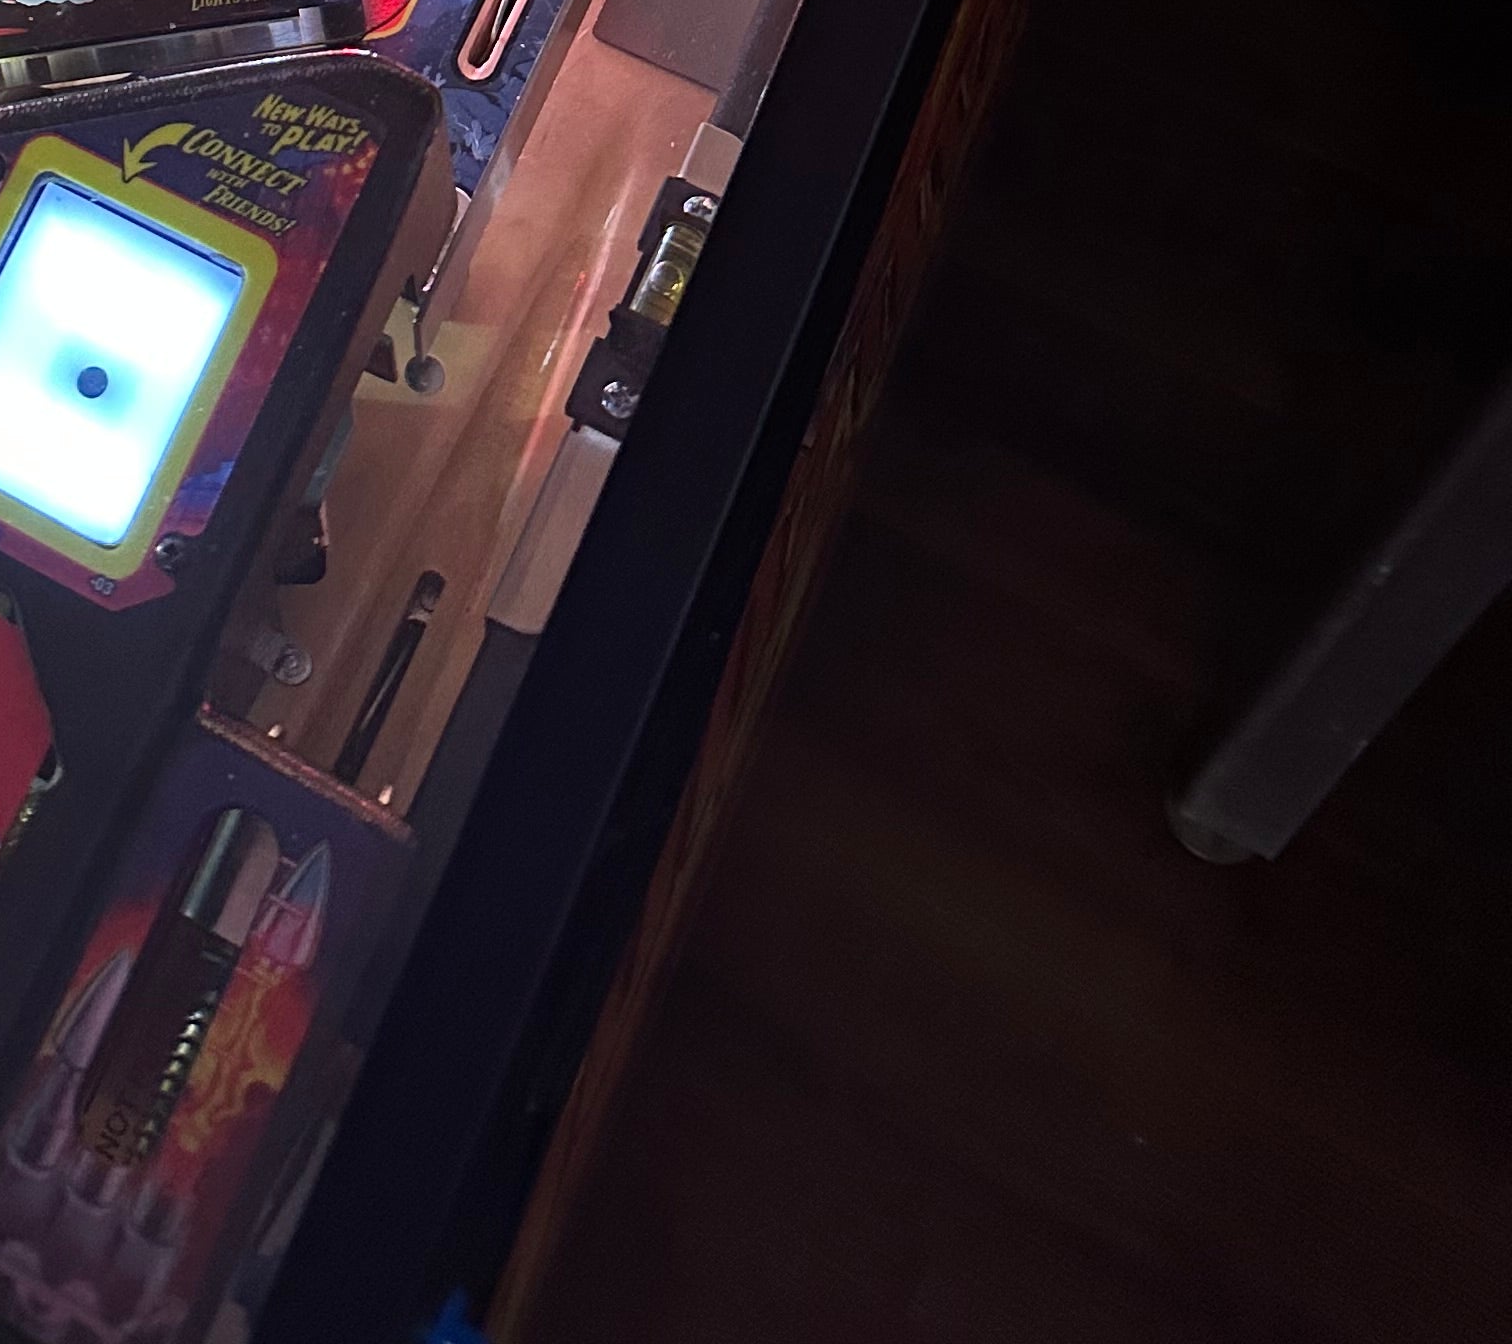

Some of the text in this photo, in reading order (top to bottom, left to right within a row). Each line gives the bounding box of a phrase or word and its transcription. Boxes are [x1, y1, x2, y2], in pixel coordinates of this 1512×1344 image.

[252, 94, 360, 135] NEW WAYS
[261, 123, 369, 156] TO PLAY!
[182, 128, 308, 195] CONNECT
[207, 168, 248, 189] WITH
[202, 184, 297, 237] FRIENDS!
[90, 577, 114, 595] -03
